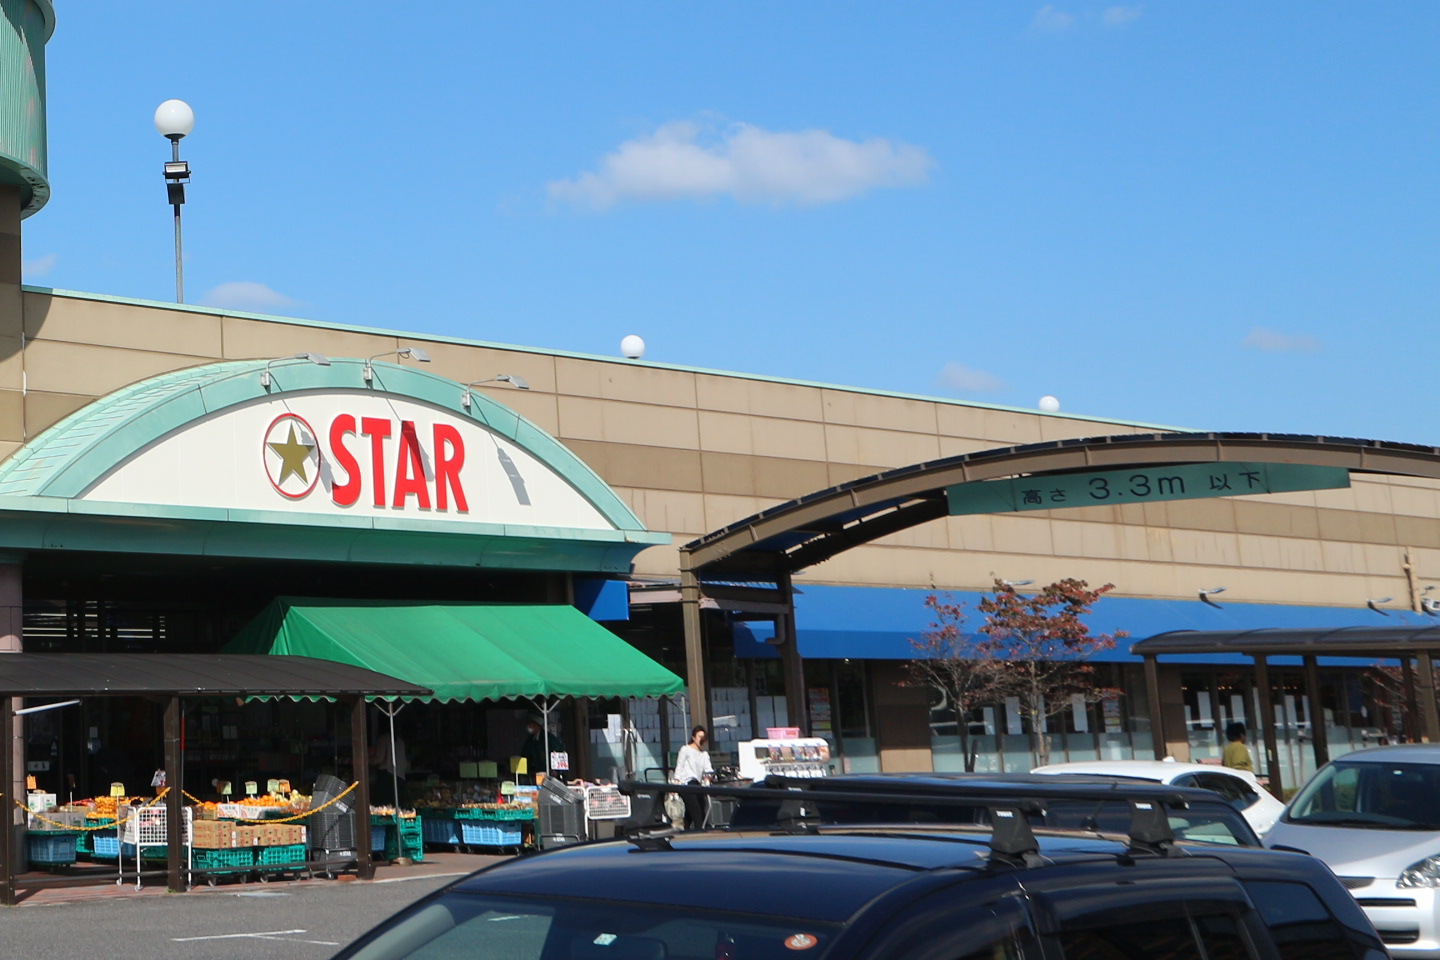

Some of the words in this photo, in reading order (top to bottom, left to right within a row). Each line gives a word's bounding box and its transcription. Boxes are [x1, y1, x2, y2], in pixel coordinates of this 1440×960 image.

[329, 413, 469, 513] STAR
[1021, 487, 1067, 506] 高さ
[1088, 473, 1186, 501] 3.3m
[1208, 471, 1262, 492] 以下
